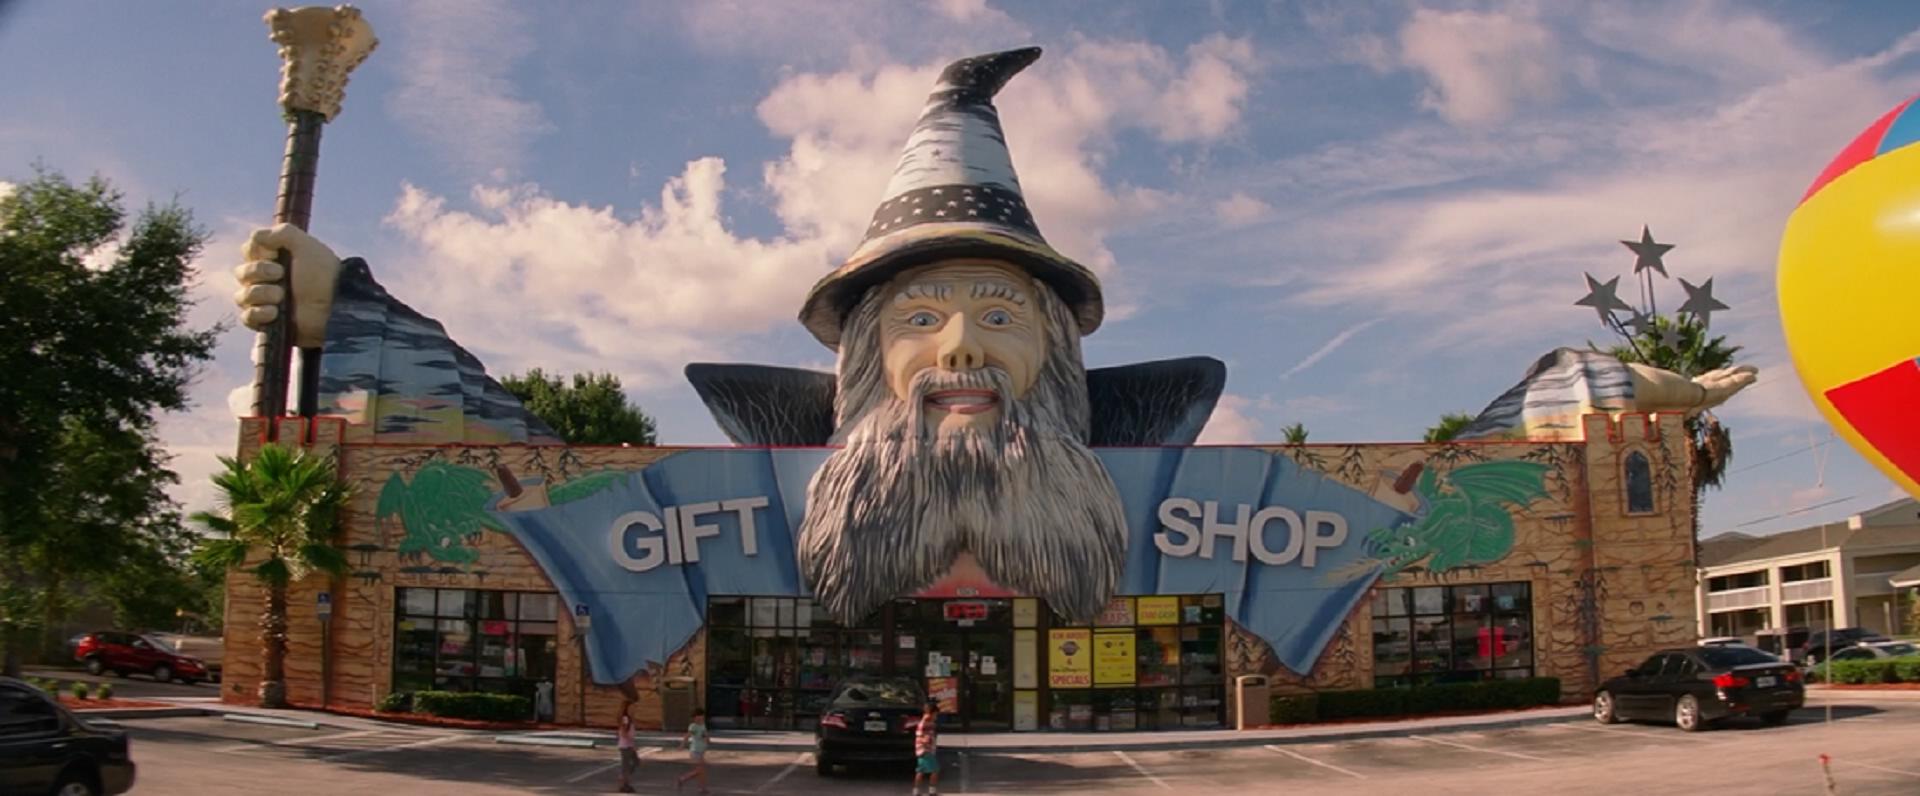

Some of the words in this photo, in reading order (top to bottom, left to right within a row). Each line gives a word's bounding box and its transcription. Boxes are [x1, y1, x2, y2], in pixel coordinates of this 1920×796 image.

[611, 496, 768, 571] GIFT
[1153, 497, 1348, 567] SHOP
[1051, 675, 1090, 685] SPECIALS
